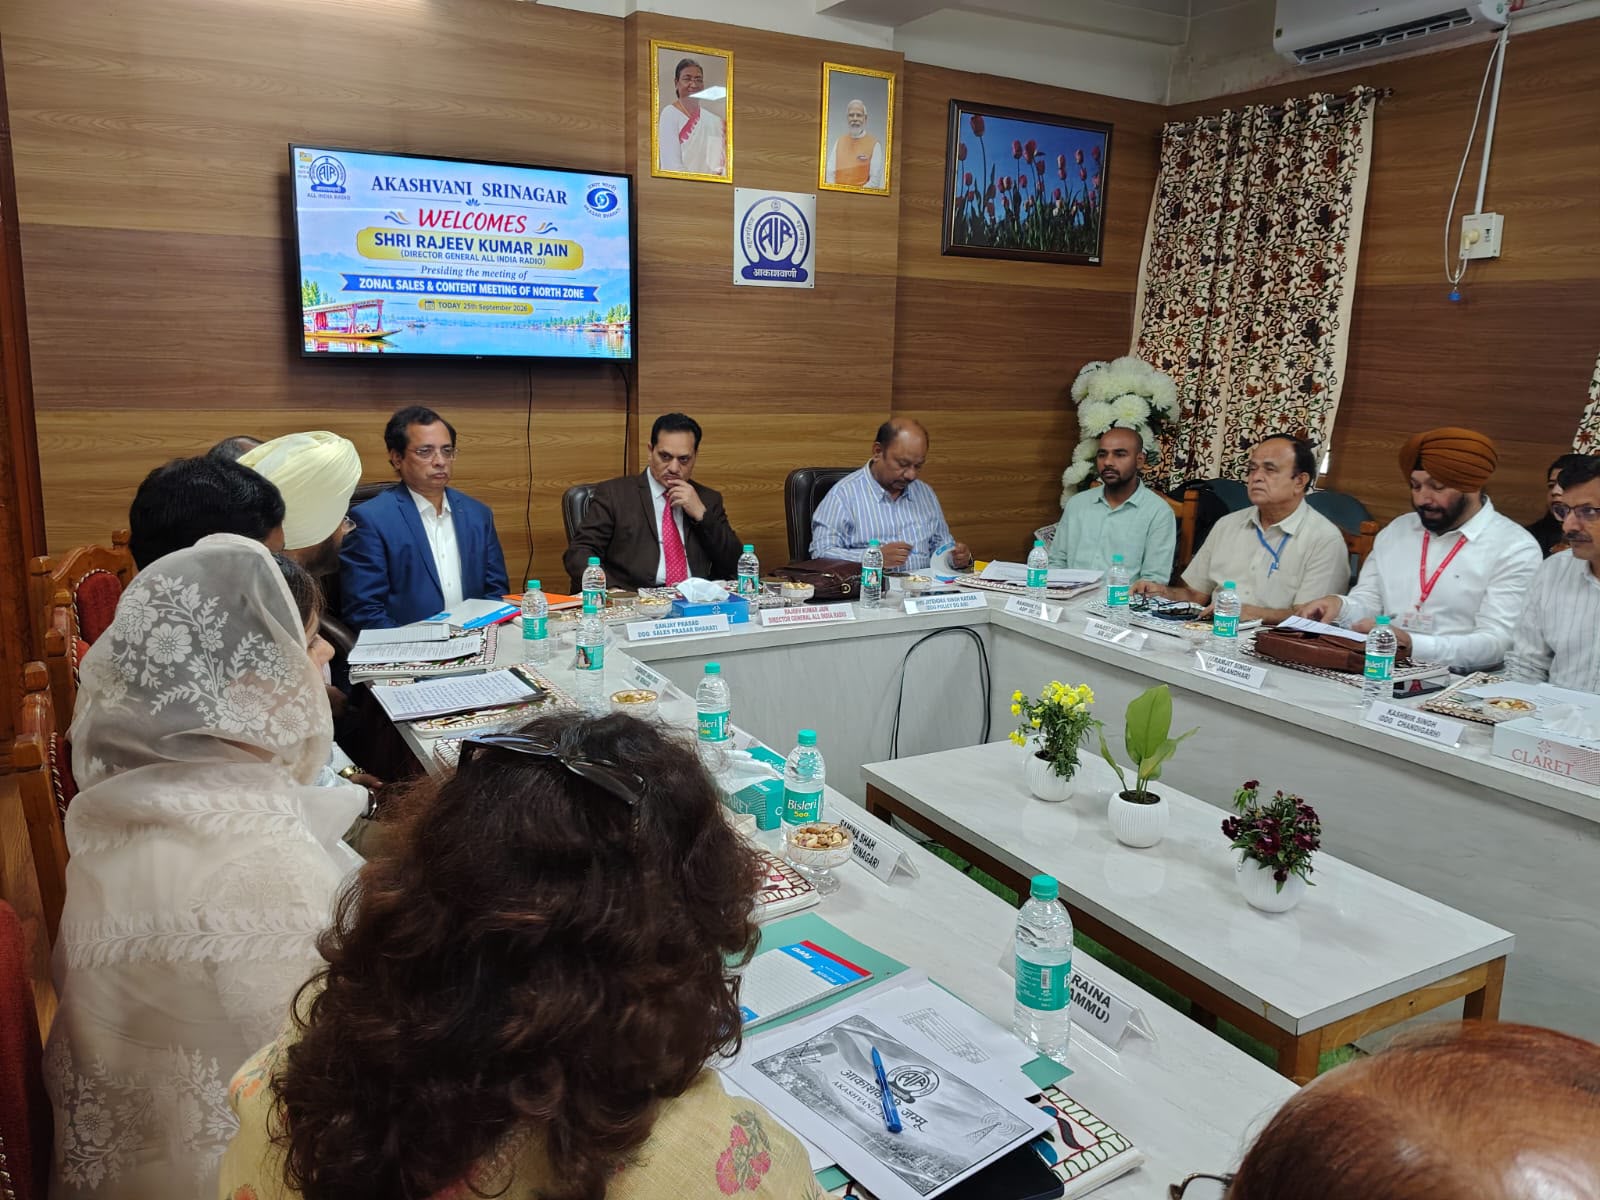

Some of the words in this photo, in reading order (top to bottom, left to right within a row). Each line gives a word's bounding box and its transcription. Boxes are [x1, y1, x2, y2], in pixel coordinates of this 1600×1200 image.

[371, 175, 472, 195] AKASHVANI
[482, 182, 568, 205] SRINAGAR
[419, 208, 527, 234] WELCOMES
[374, 232, 411, 247] SHRI
[416, 234, 474, 251] RAJEEV
[479, 238, 533, 255] KUMAR
[537, 242, 568, 257] JAIN
[759, 217, 793, 255] AIR
[400, 249, 443, 260] (DIRECTOR
[445, 252, 480, 261] GENERAL
[481, 254, 495, 262] ALL
[496, 255, 517, 264] INDIA
[519, 257, 546, 266] RADIO)
[420, 265, 464, 277] Presiding
[465, 268, 481, 277] the
[482, 268, 516, 280] meeting
[518, 270, 528, 280] of
[753, 267, 797, 278] आकाशवाणी
[359, 277, 394, 290] ZONAL
[395, 279, 425, 291] SALES
[427, 281, 434, 291] &
[435, 281, 477, 293] CONTENT
[479, 283, 517, 295] MEETING
[519, 286, 531, 296] OF
[532, 286, 561, 297] NORTH
[563, 287, 584, 298] ZONE
[438, 301, 460, 309] TODAY
[479, 303, 511, 312] September
[1416, 716, 1438, 728] SINGH
[1511, 748, 1577, 775] CLARET
[787, 798, 817, 811] Bisleri
[859, 833, 877, 852] SHAH
[853, 841, 880, 870] RINAGAR)
[1070, 974, 1111, 1009] RAINA
[1069, 988, 1110, 1023] AMMU)
